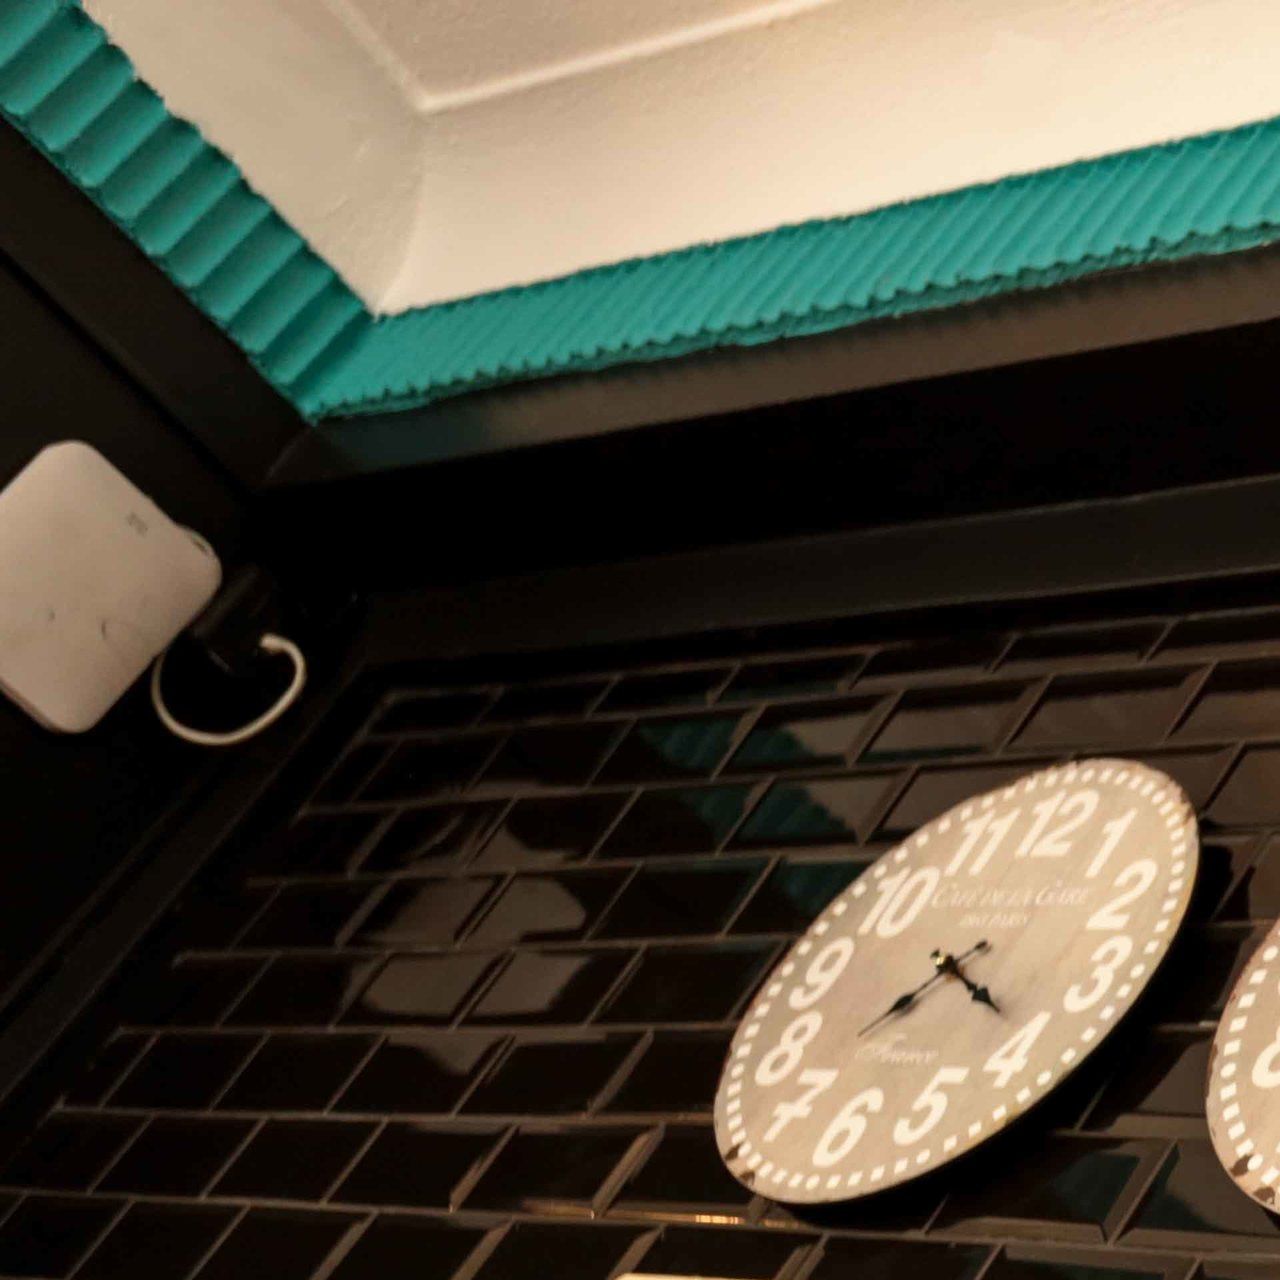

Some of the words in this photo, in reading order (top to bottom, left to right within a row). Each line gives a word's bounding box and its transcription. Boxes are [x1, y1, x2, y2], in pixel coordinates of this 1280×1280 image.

[945, 809, 1019, 876] 11
[1016, 790, 1099, 856] 12
[1087, 809, 1136, 876] 1
[859, 867, 940, 937] 10
[1086, 859, 1157, 930] 2
[789, 938, 854, 1010] 9
[1063, 936, 1132, 1012] 3
[755, 1012, 822, 1086] 8
[983, 1011, 1050, 1088] 4
[764, 1069, 838, 1142] 7
[812, 1088, 884, 1168] 6
[893, 1067, 969, 1145] 5
